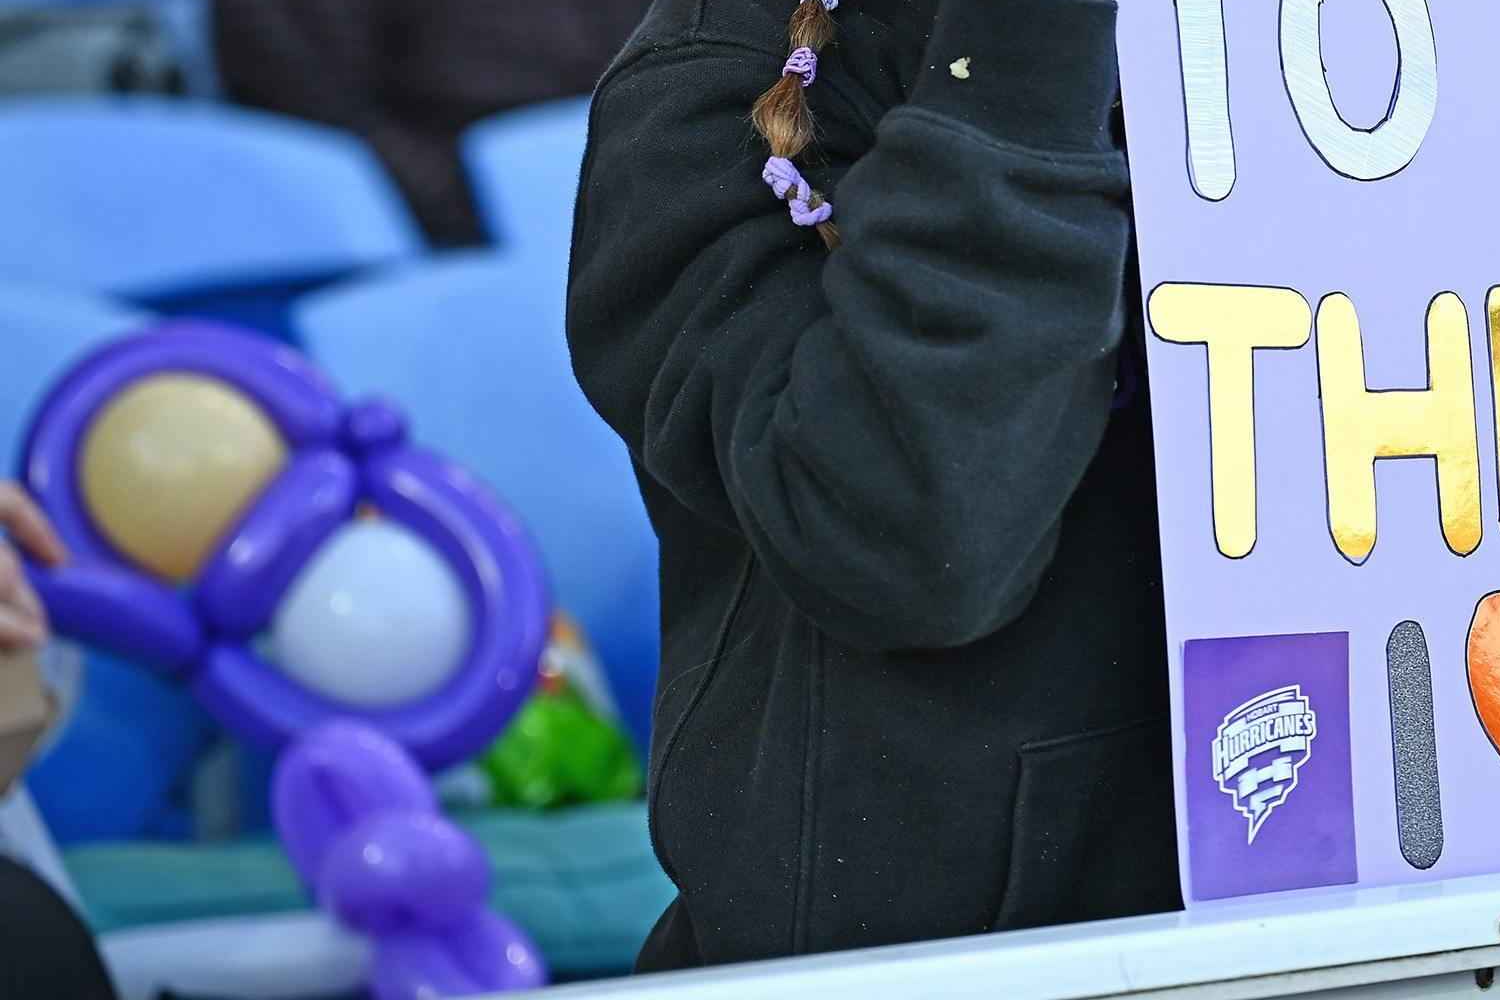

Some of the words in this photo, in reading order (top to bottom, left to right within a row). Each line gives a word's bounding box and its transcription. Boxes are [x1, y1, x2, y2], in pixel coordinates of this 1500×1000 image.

[1245, 702, 1279, 721] HOBART
[1215, 713, 1313, 775] HURRICANES
[1386, 619, 1443, 871] I
